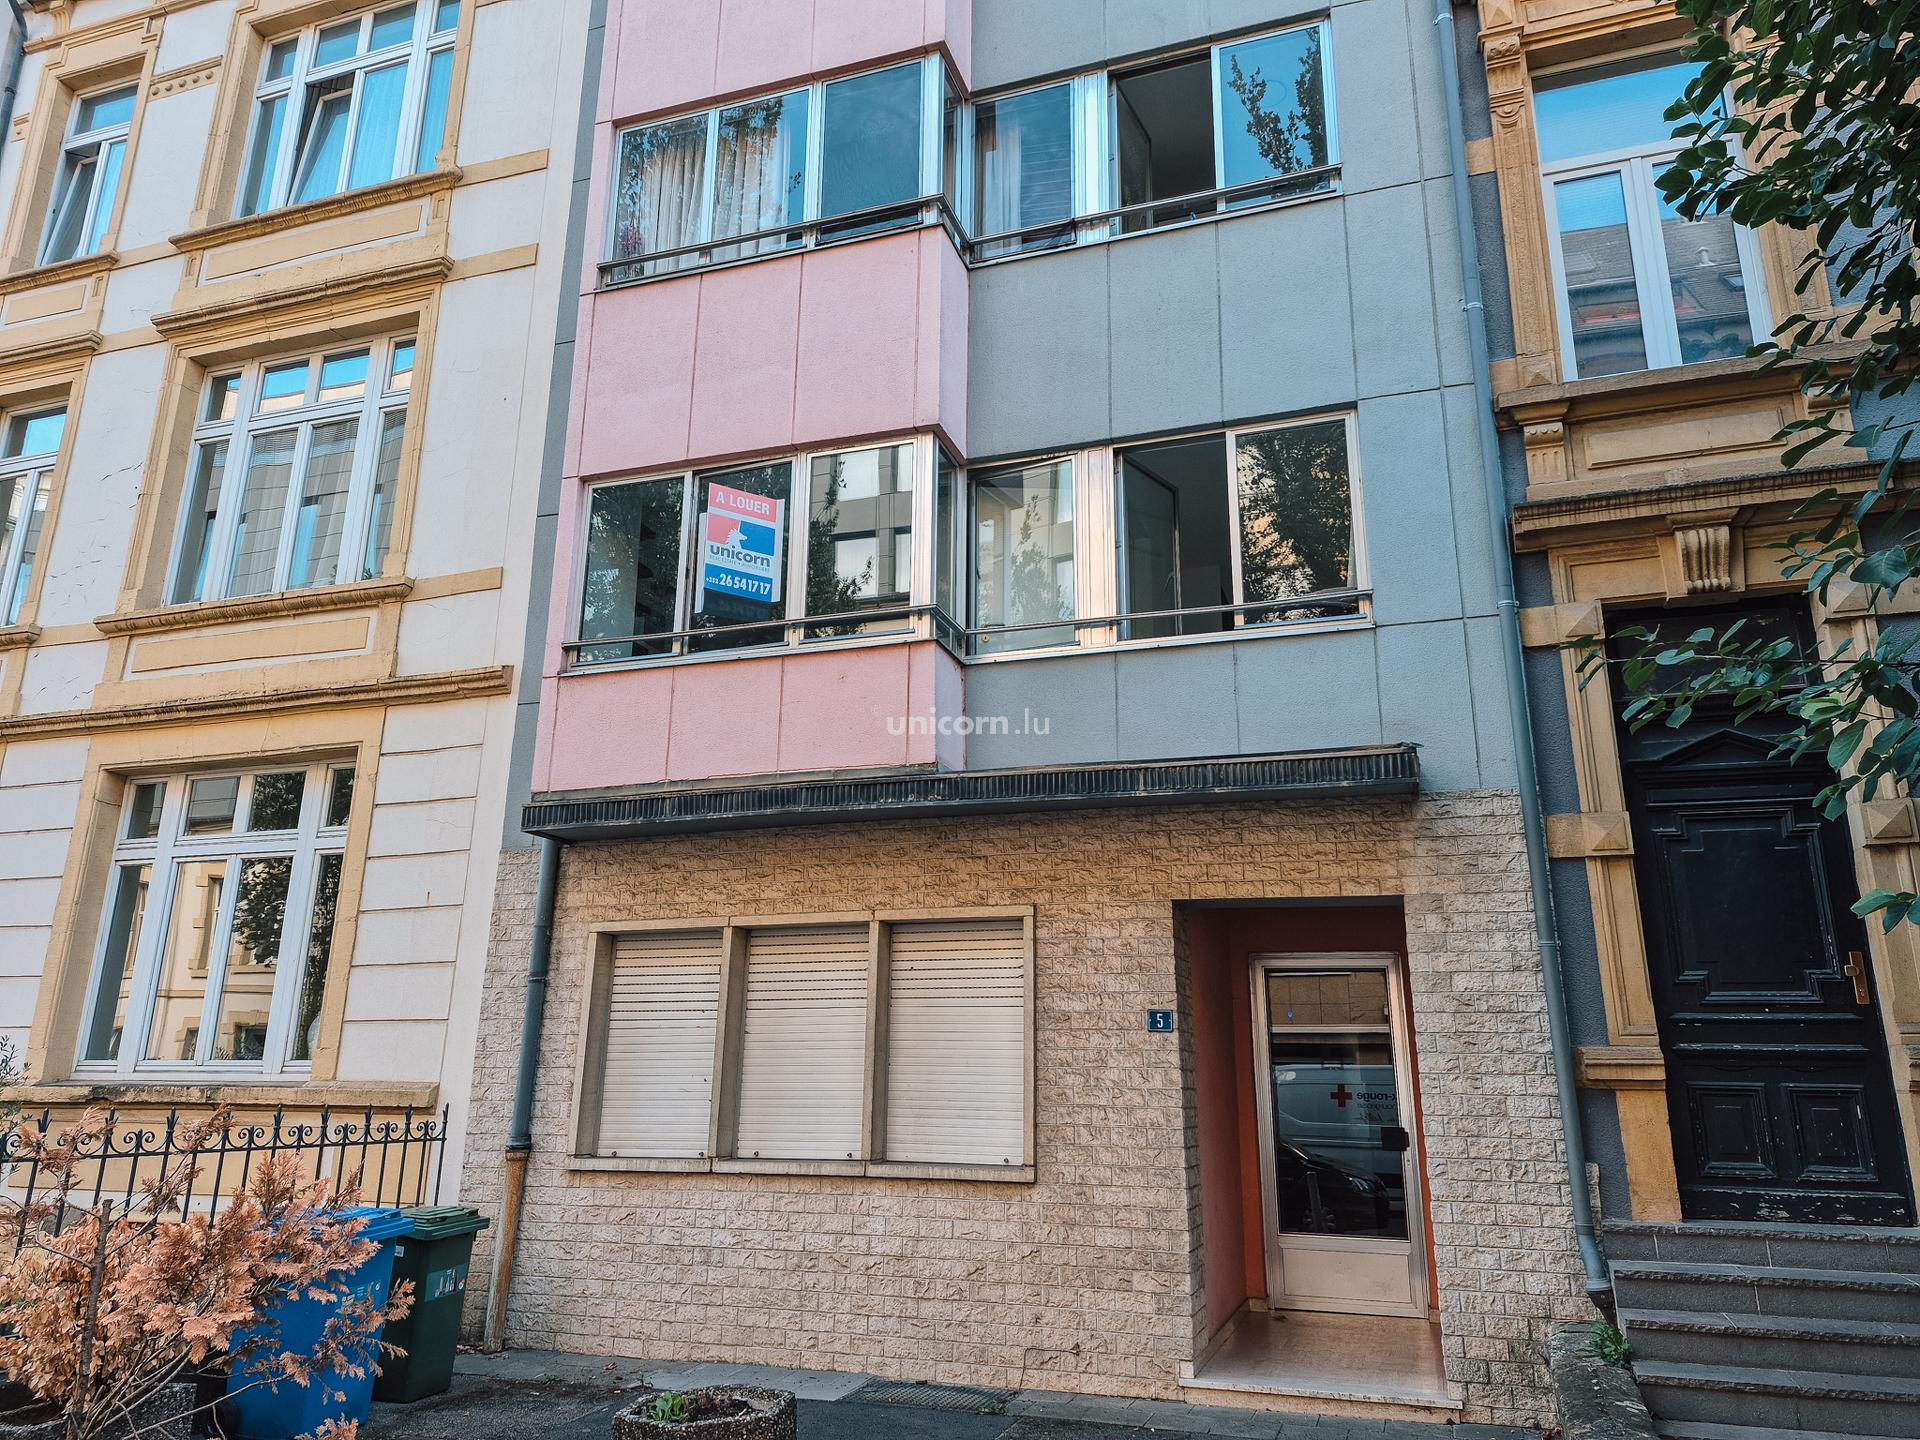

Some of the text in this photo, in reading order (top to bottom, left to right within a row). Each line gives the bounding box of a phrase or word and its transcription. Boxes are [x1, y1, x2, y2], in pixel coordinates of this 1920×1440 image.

[716, 491, 770, 515] A LOUER
[710, 545, 771, 568] unicorn
[1156, 1013, 1164, 1028] 5
